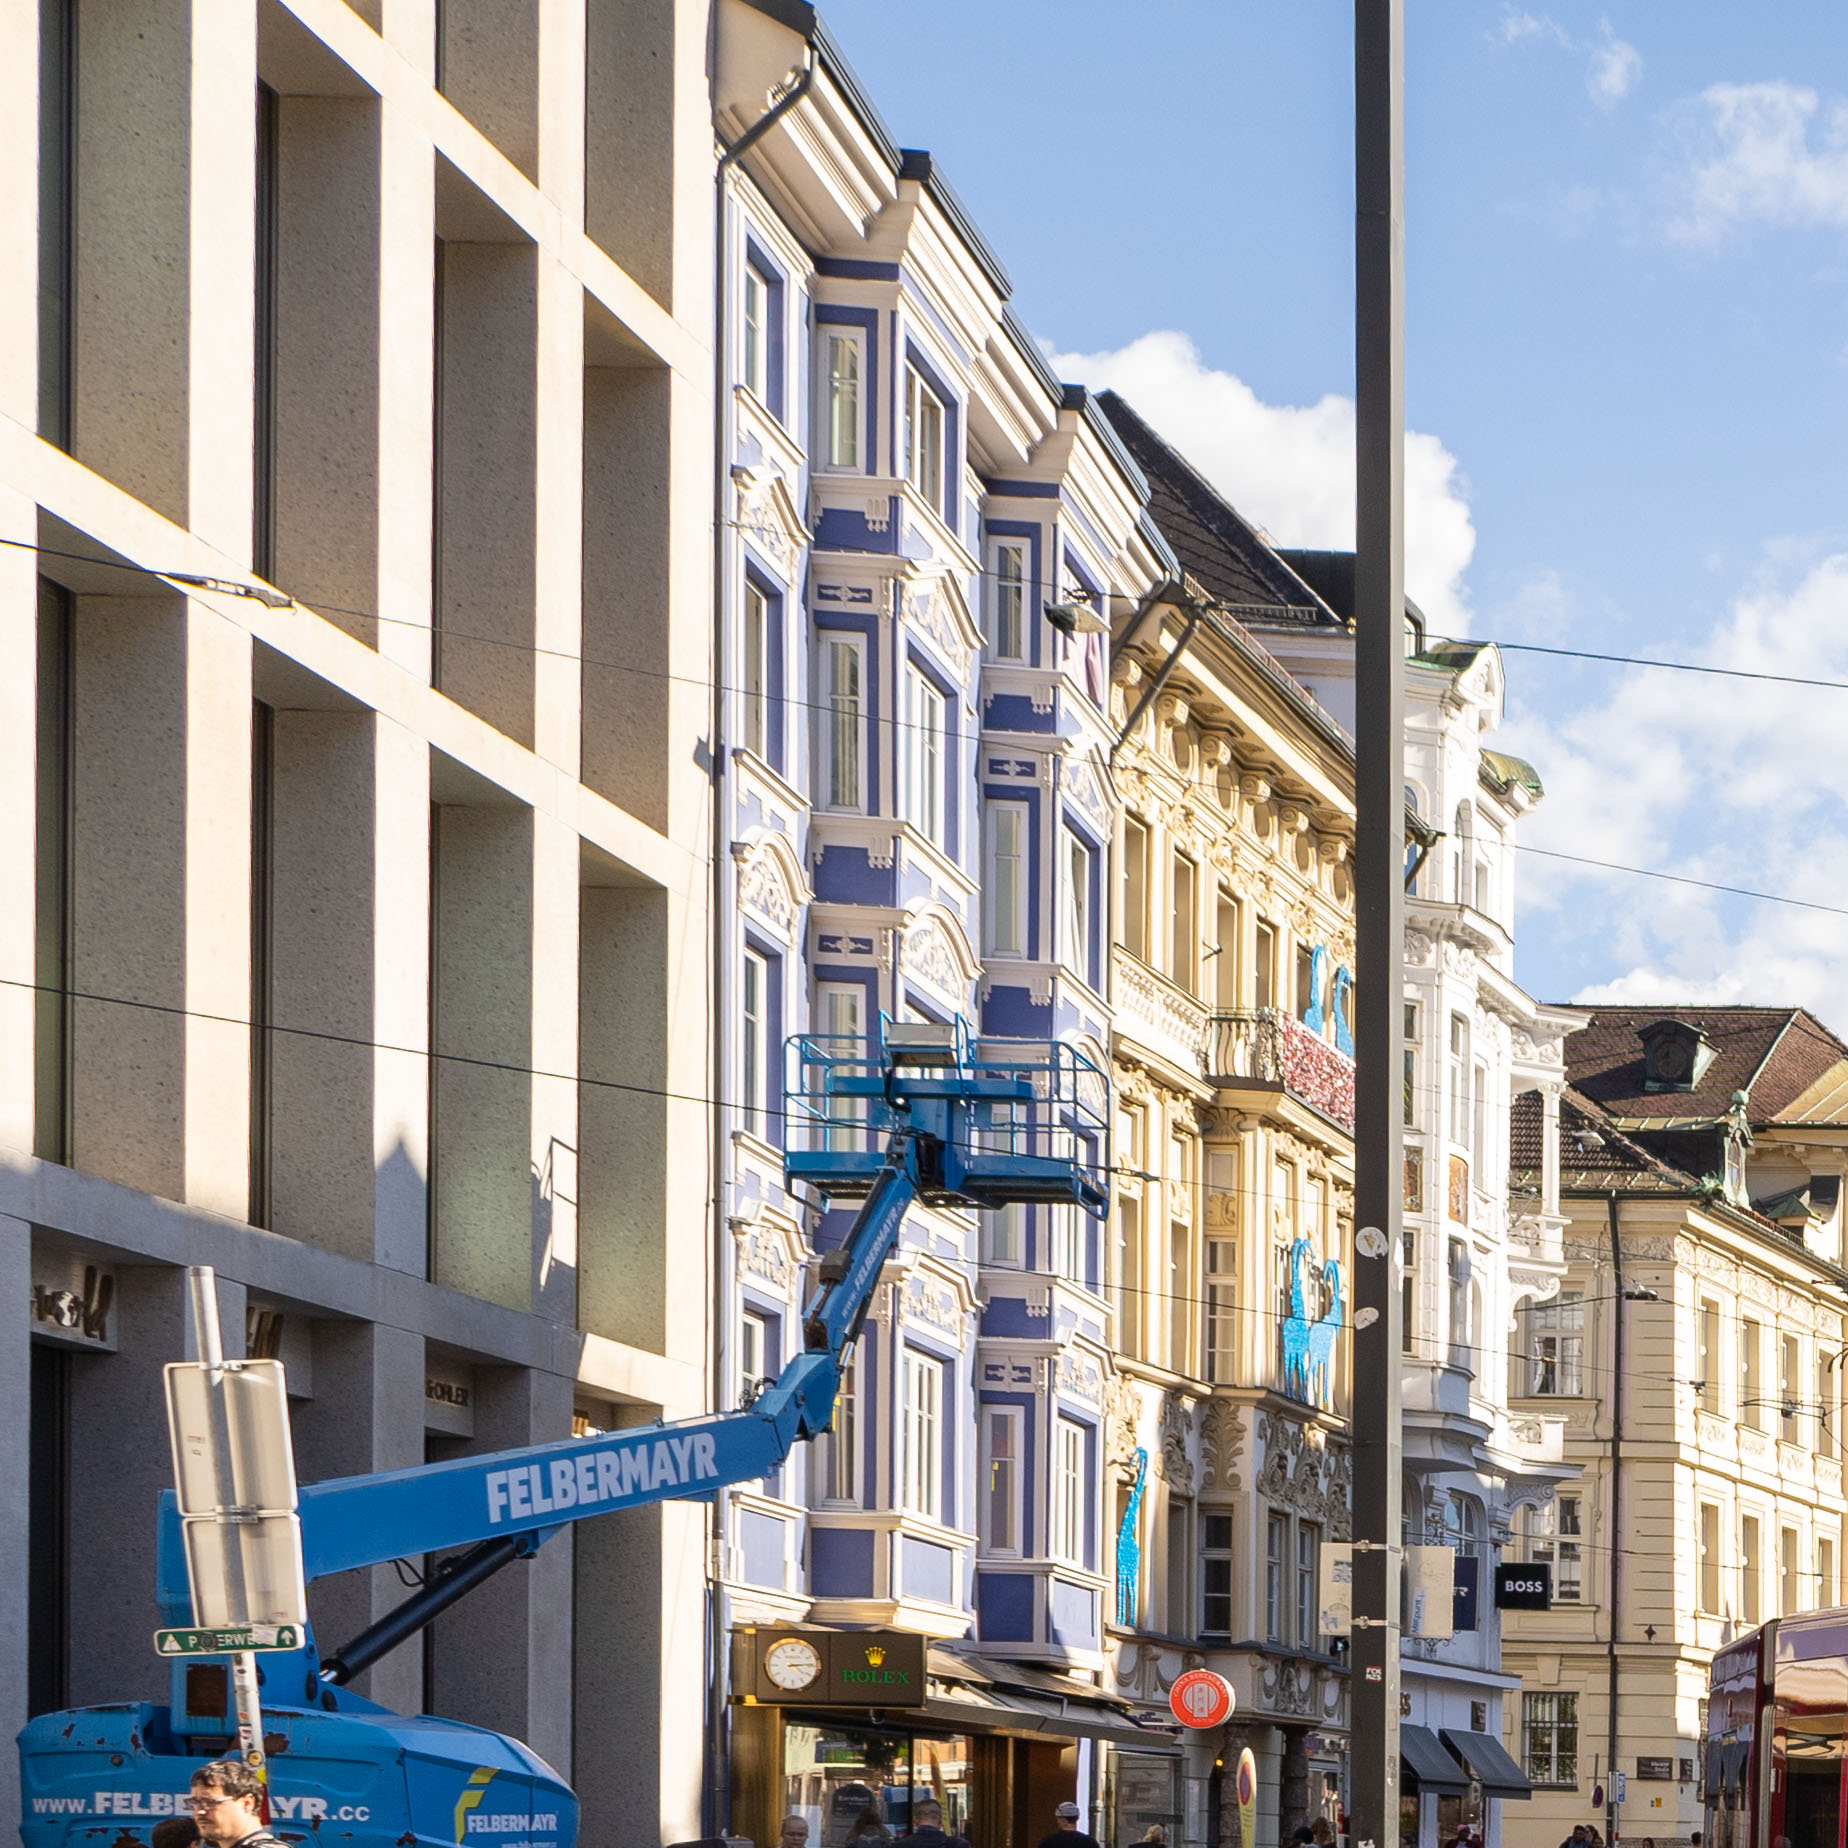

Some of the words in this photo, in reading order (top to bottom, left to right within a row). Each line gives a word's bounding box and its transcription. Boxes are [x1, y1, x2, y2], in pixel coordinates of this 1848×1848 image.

[485, 1432, 719, 1524] FELBERMAYR
[1505, 1580, 1543, 1593] BOSS
[841, 1670, 909, 1684] ROLEX
[466, 1813, 558, 1833] FELBERMAYR
